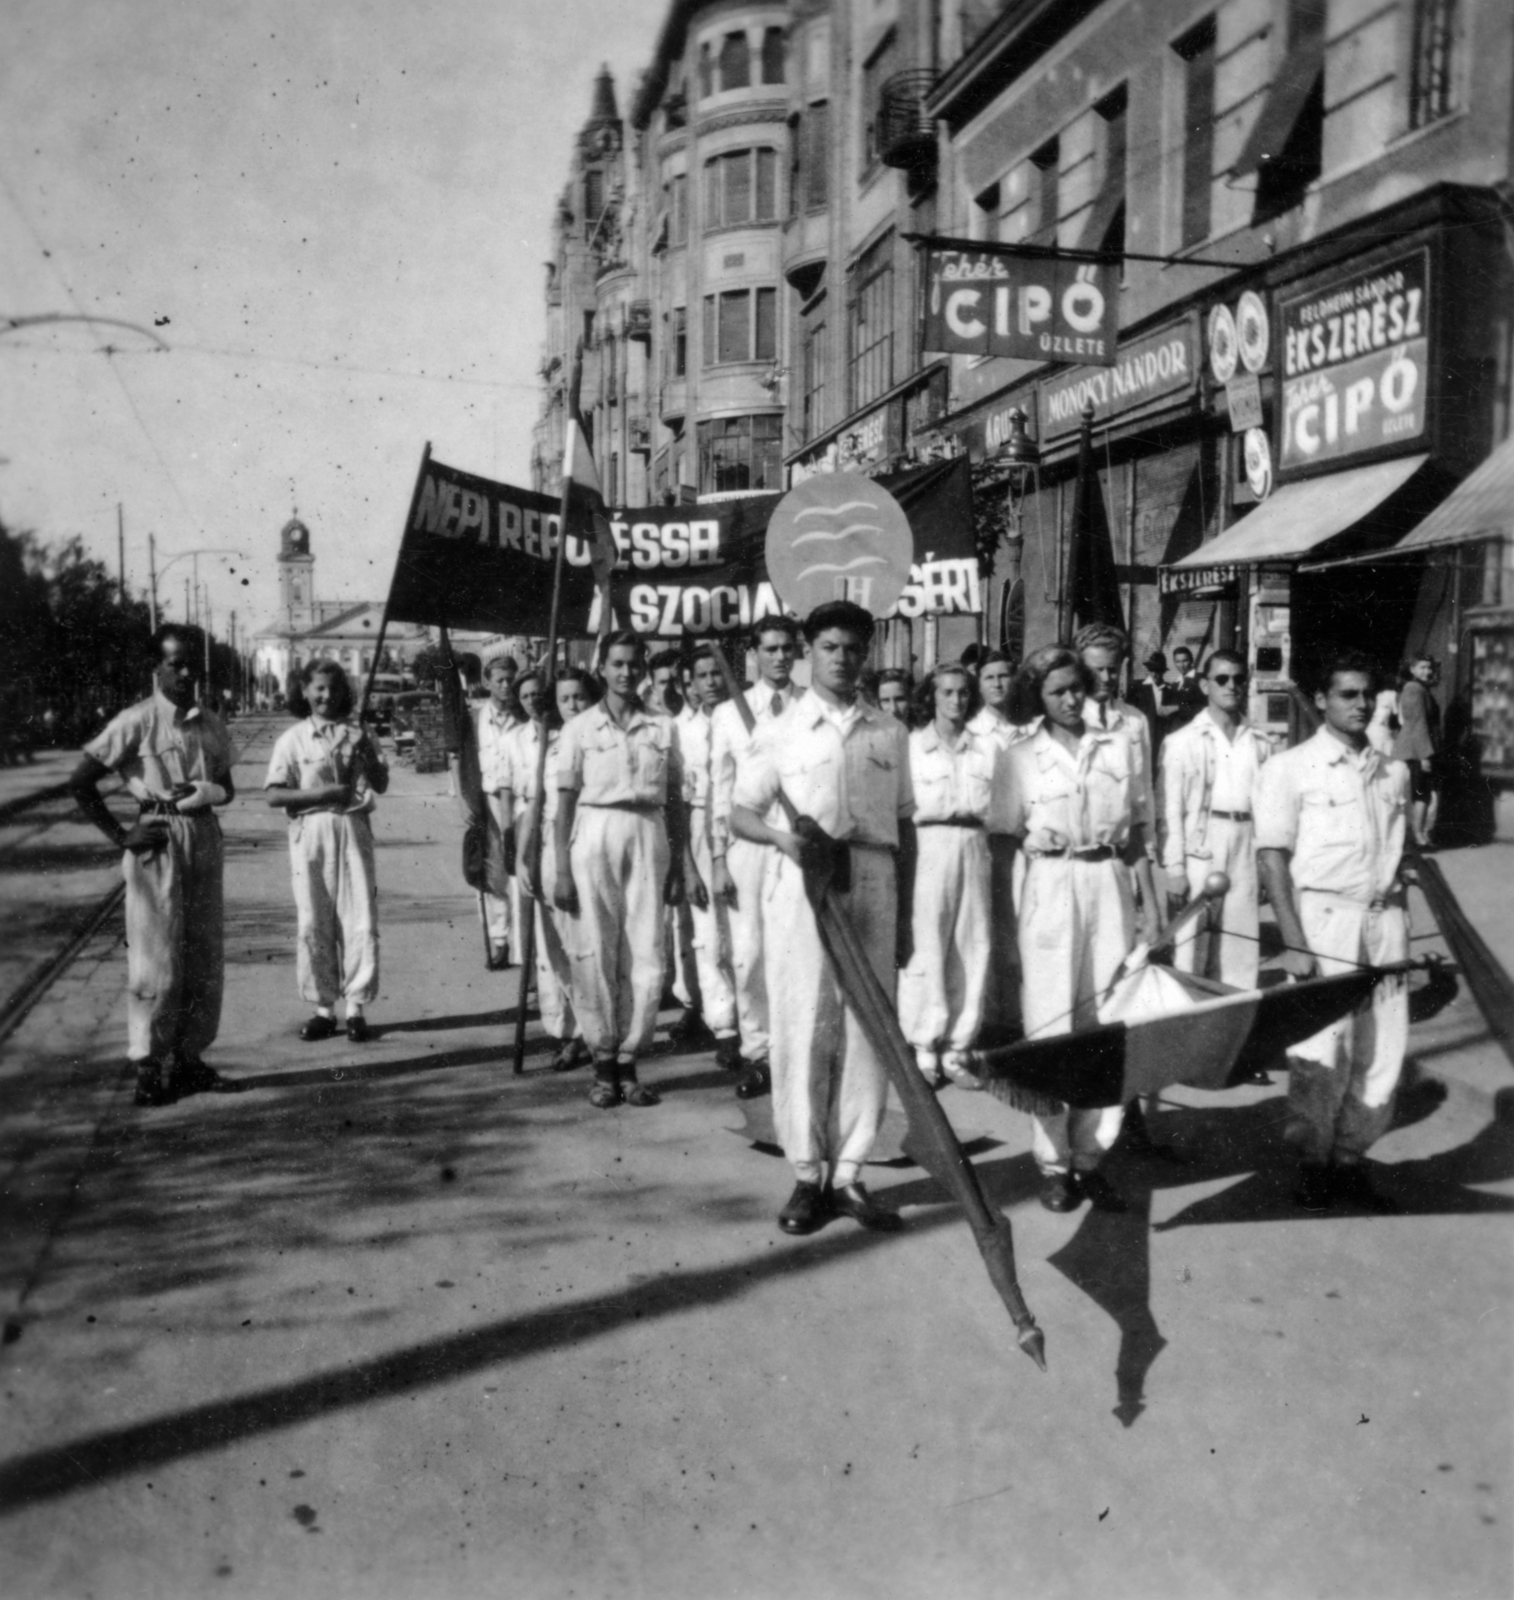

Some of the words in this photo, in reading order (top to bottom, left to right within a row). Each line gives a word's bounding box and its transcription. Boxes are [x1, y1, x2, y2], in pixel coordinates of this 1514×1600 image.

[945, 264, 1105, 339] CIPŐ
[1285, 288, 1422, 376] ÉKSZERÉSZ
[1040, 332, 1106, 356] ÜZLETE
[1048, 369, 1111, 423] MONOKY
[1111, 340, 1188, 398] NÁNDOR
[1295, 344, 1419, 455] CIPŐ
[413, 473, 490, 545] NÉPI
